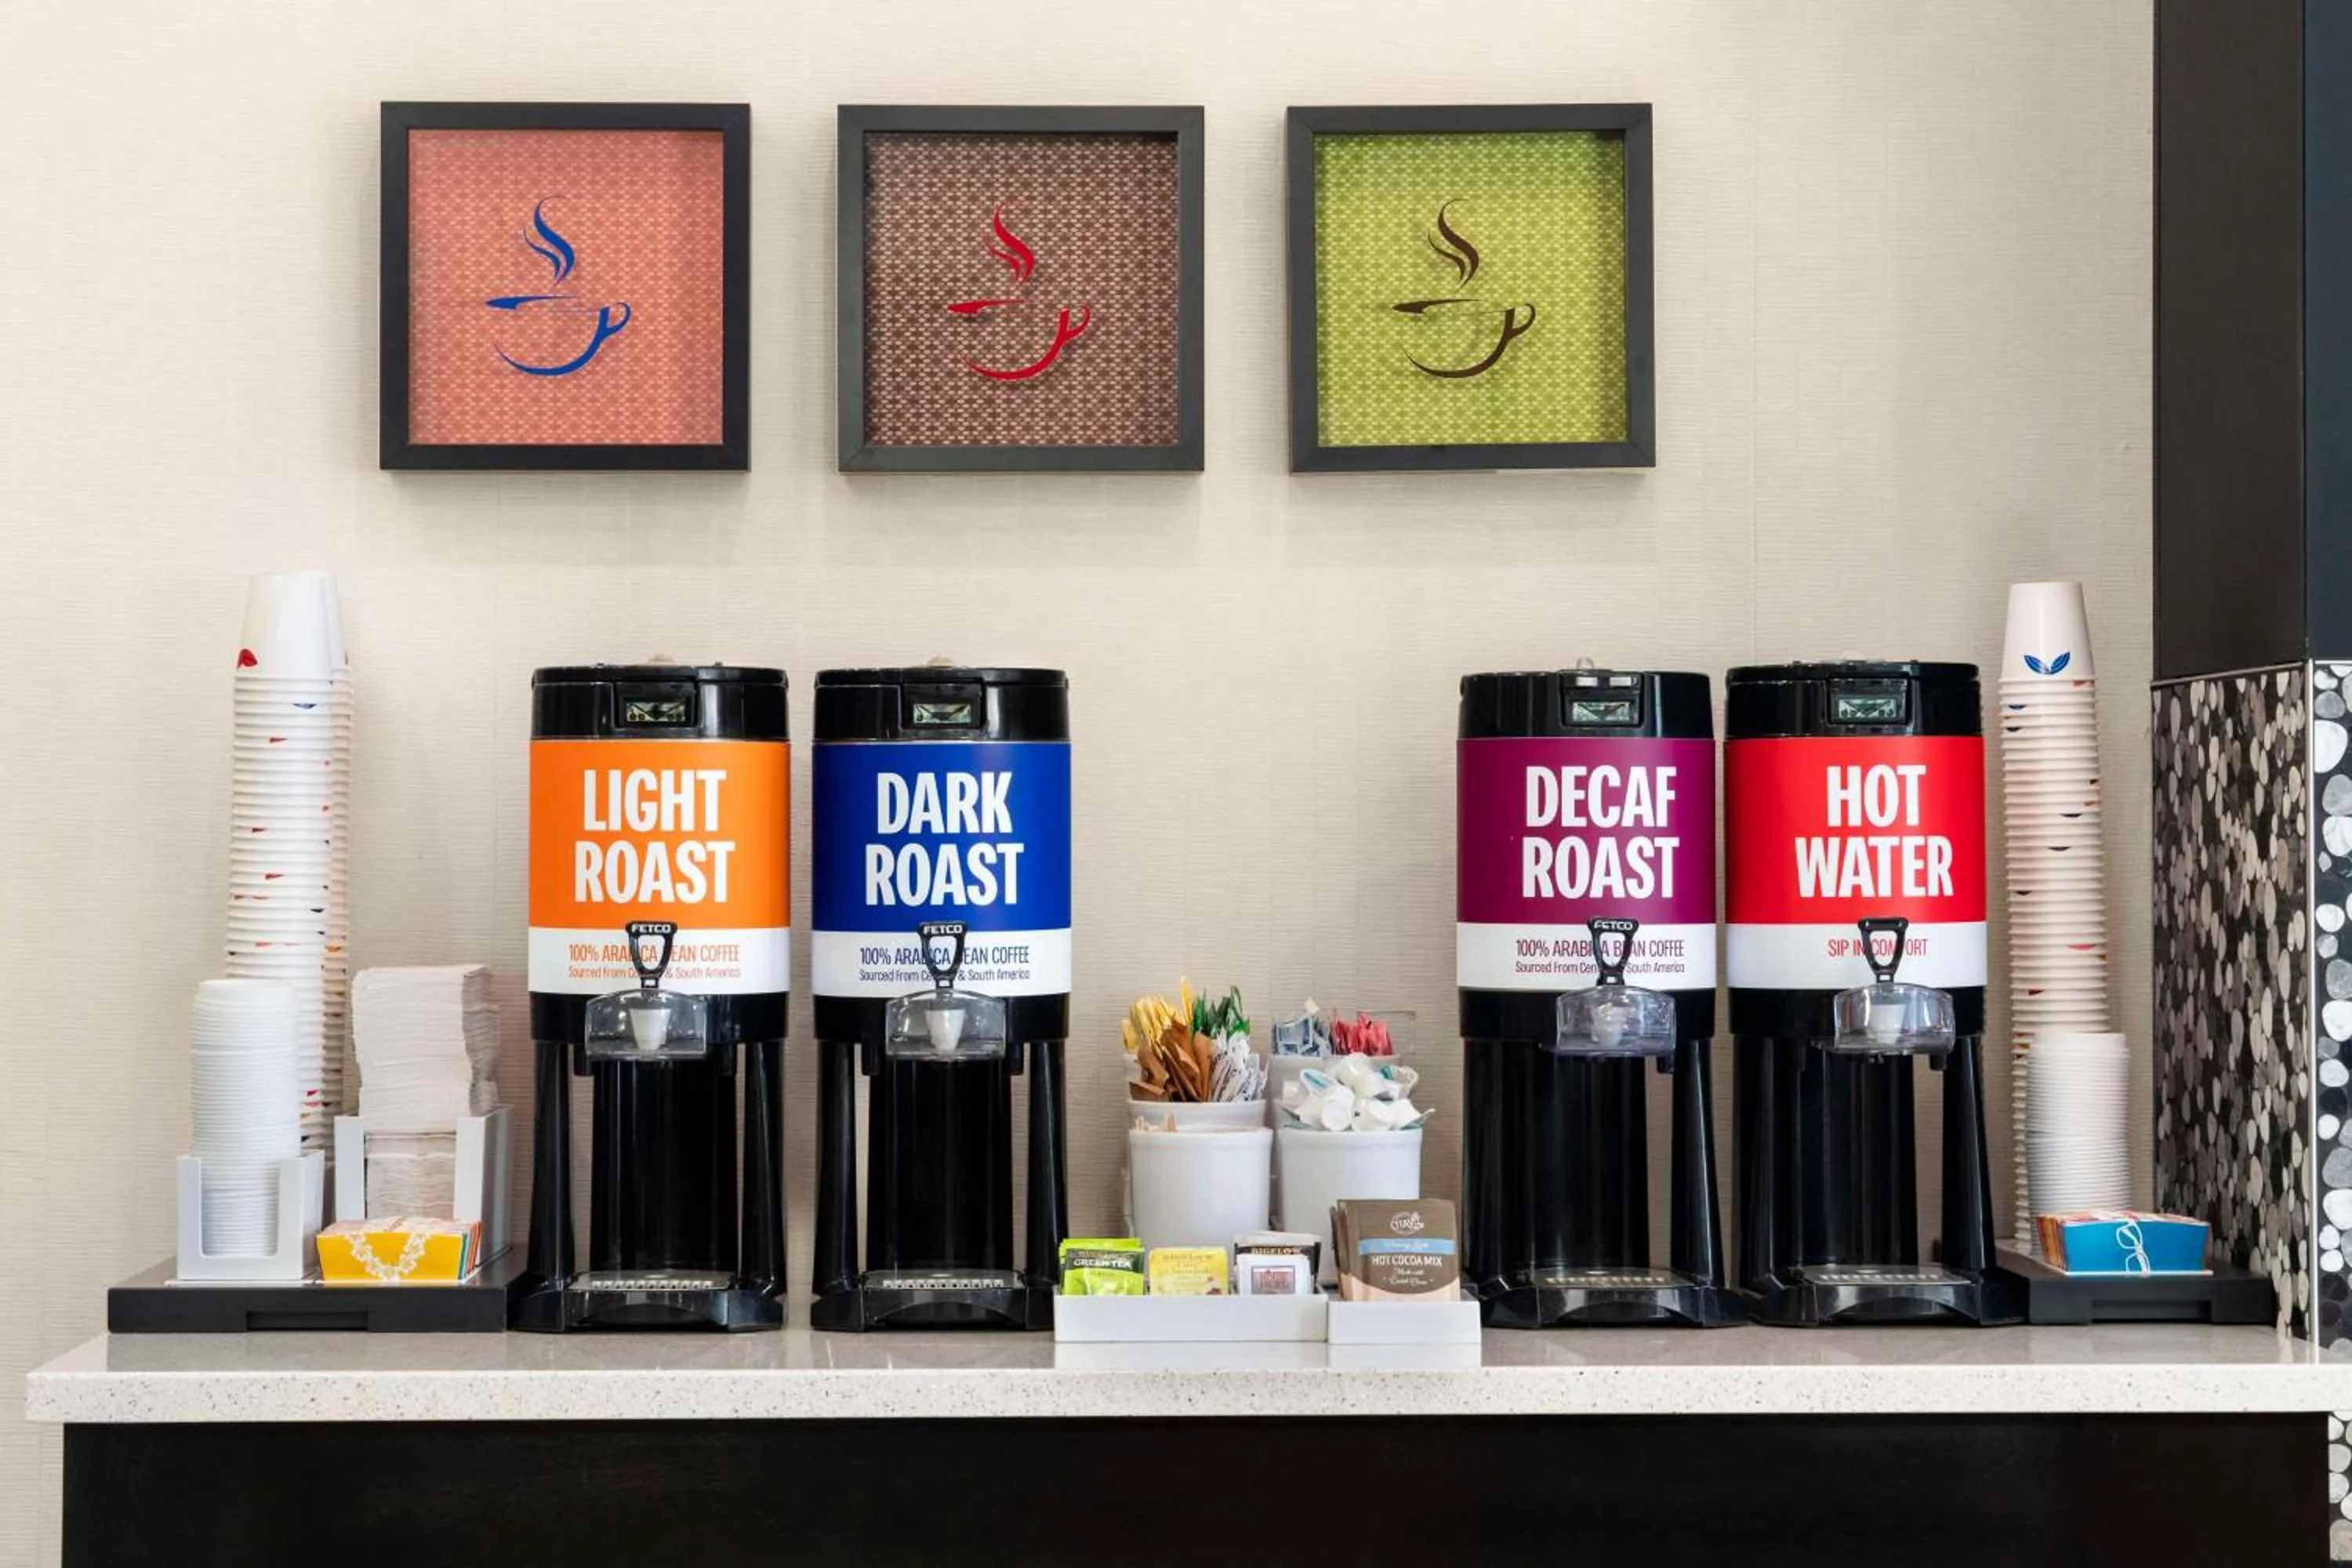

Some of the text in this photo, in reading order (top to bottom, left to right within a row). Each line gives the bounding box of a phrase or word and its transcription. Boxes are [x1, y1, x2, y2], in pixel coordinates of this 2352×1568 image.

[583, 768, 728, 833] LIGHT
[877, 771, 1014, 835] DARK
[1526, 764, 1678, 829] DECAF
[1827, 764, 1926, 828] HOT
[575, 840, 736, 905] ROAST
[864, 843, 1025, 907] ROAST
[1522, 835, 1681, 900] ROAST
[1795, 835, 1955, 898] WATER
[631, 924, 671, 934] FETCO
[923, 924, 963, 935] FETCO
[1594, 920, 1634, 931] FETCO
[569, 943, 741, 962] 100% ARACA EAN COFFEE
[860, 946, 1029, 965] 100% ARACA EAN COFFEE
[1515, 938, 1685, 957] 100% ARABIA BAN COFFEE
[1828, 938, 1849, 957] SIP
[1871, 938, 1928, 957] COMORT
[568, 965, 601, 978] Sourced
[603, 965, 627, 978] From
[676, 966, 702, 978] South
[858, 968, 895, 982] Sourced
[896, 968, 920, 981] From
[968, 968, 995, 981] South
[996, 967, 1030, 980] America
[1515, 961, 1552, 974] Sourced
[1554, 961, 1578, 974] From
[1626, 961, 1653, 974] South
[1653, 960, 1686, 973] America
[1112, 1259, 1131, 1268] TEA
[1371, 1254, 1443, 1267] HOT COCOA MIX
